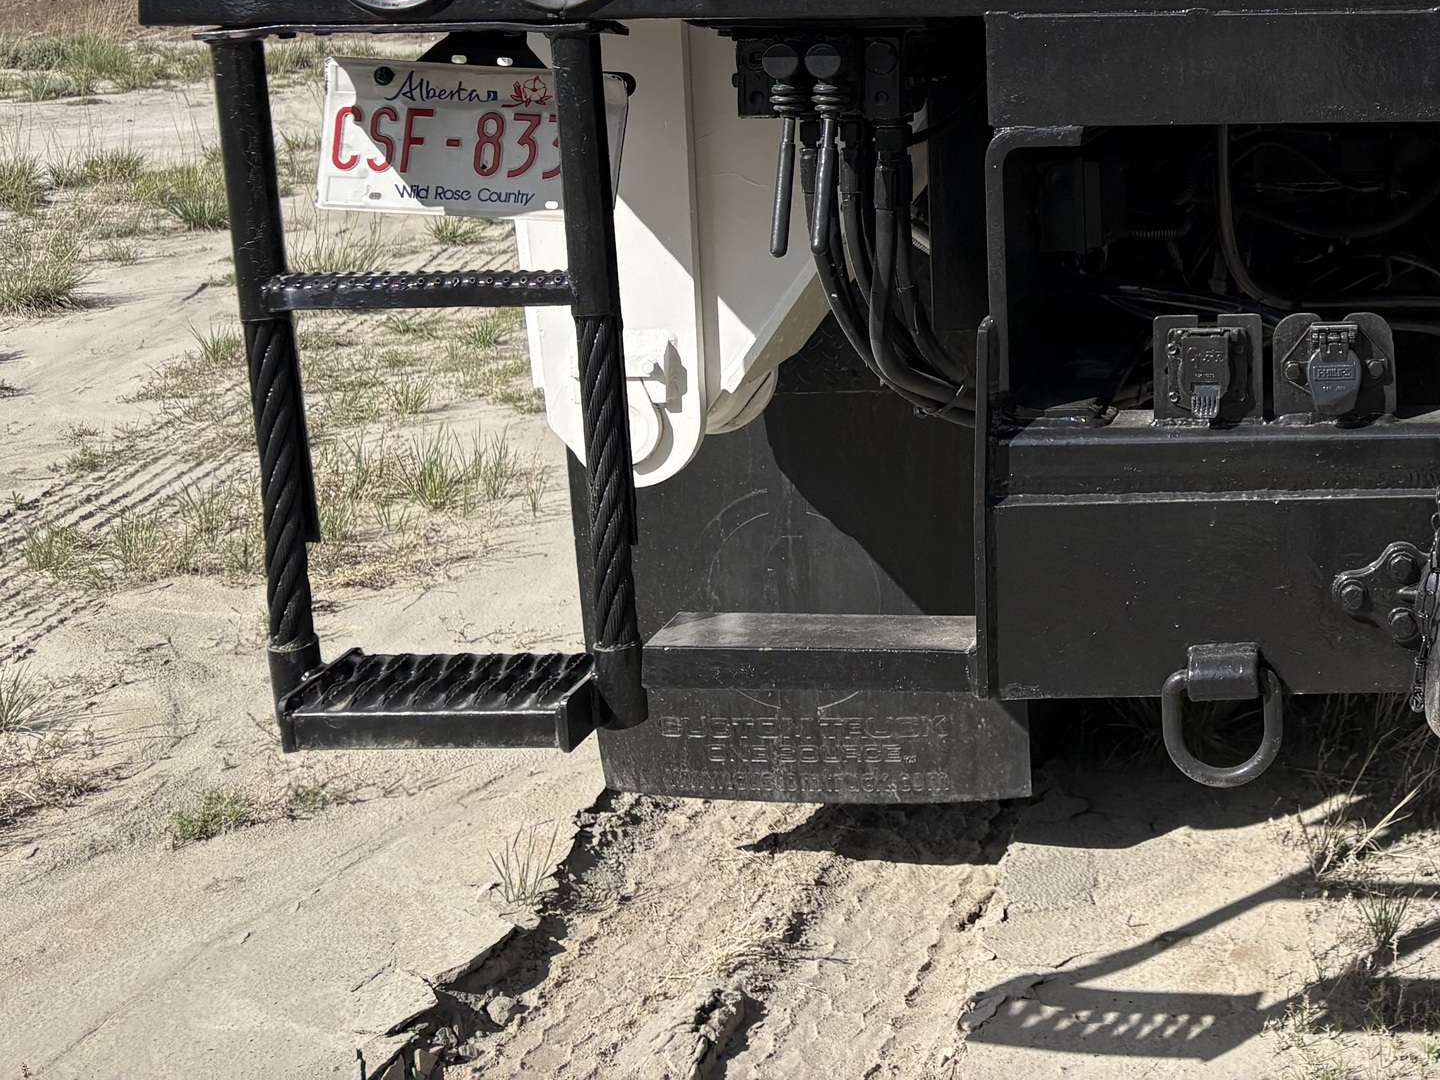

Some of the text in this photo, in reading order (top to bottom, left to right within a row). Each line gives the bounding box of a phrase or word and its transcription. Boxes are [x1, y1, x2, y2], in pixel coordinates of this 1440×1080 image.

[385, 71, 490, 103] Alberta
[394, 184, 535, 206] Wild Rose Country
[706, 744, 767, 764] ONE
